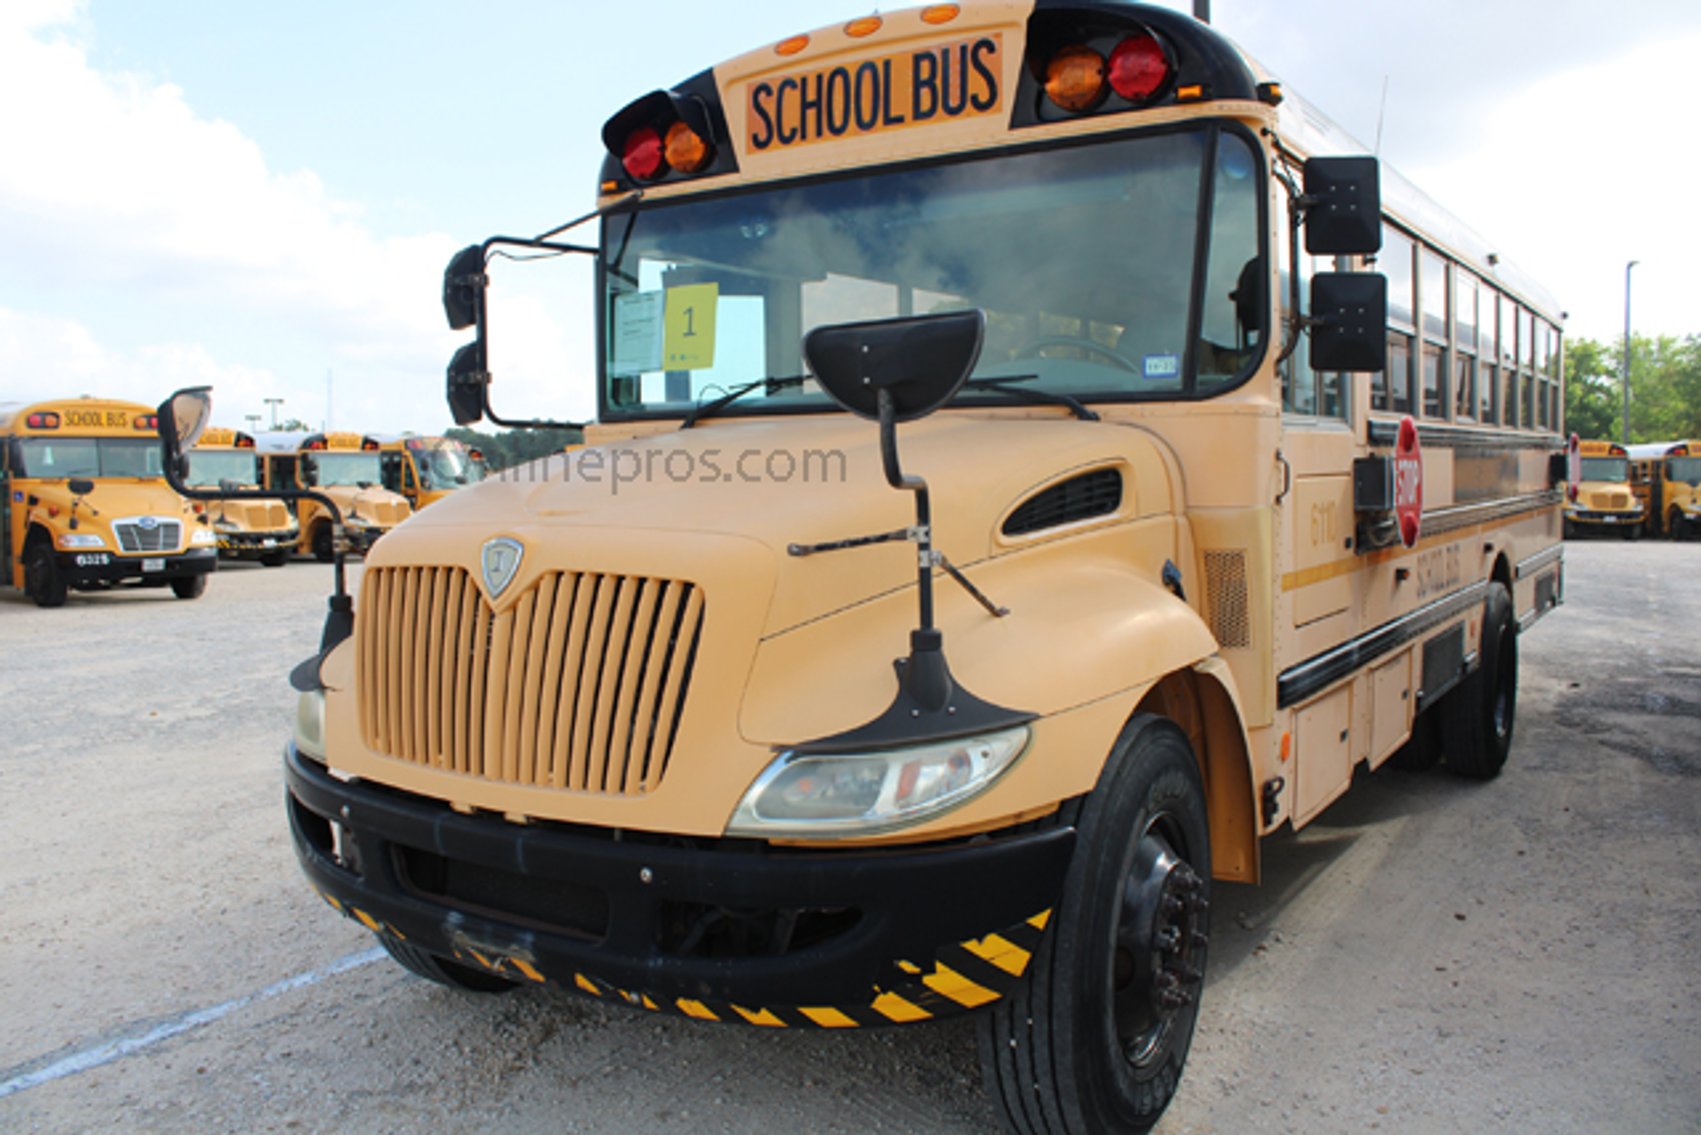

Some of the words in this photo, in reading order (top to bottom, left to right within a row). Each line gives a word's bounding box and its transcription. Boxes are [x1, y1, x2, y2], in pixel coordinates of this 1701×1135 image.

[751, 59, 905, 150] SCHOOL
[912, 37, 999, 121] BUS
[682, 306, 697, 337] 1
[65, 410, 103, 427] SCHOOL
[107, 411, 128, 428] BUS
[1397, 459, 1419, 506] STOP
